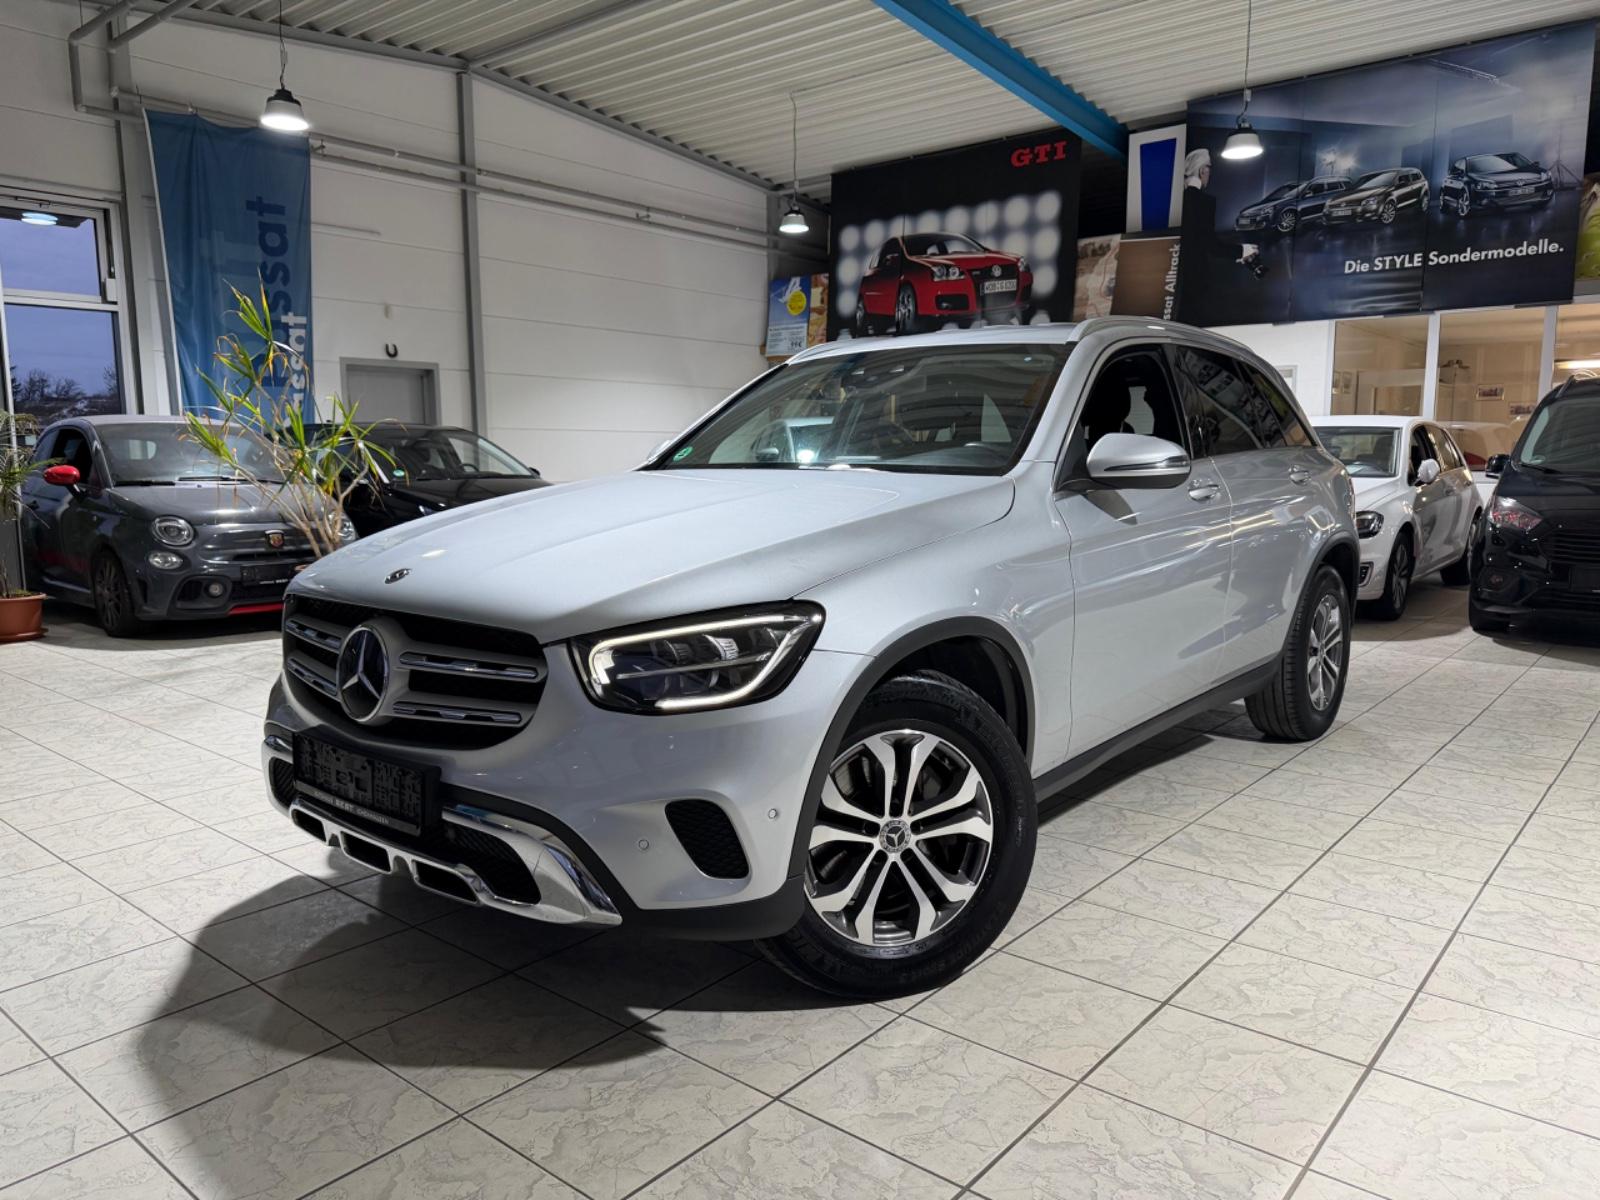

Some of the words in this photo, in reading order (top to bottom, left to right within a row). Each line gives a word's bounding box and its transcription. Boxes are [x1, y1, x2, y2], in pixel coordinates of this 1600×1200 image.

[1010, 140, 1067, 168] GTI
[1164, 242, 1182, 293] Alltrack
[1344, 260, 1369, 274] Die
[1374, 252, 1423, 271] STYLE
[1428, 238, 1564, 266] Sondermodelle.
[281, 312, 307, 425] assat
